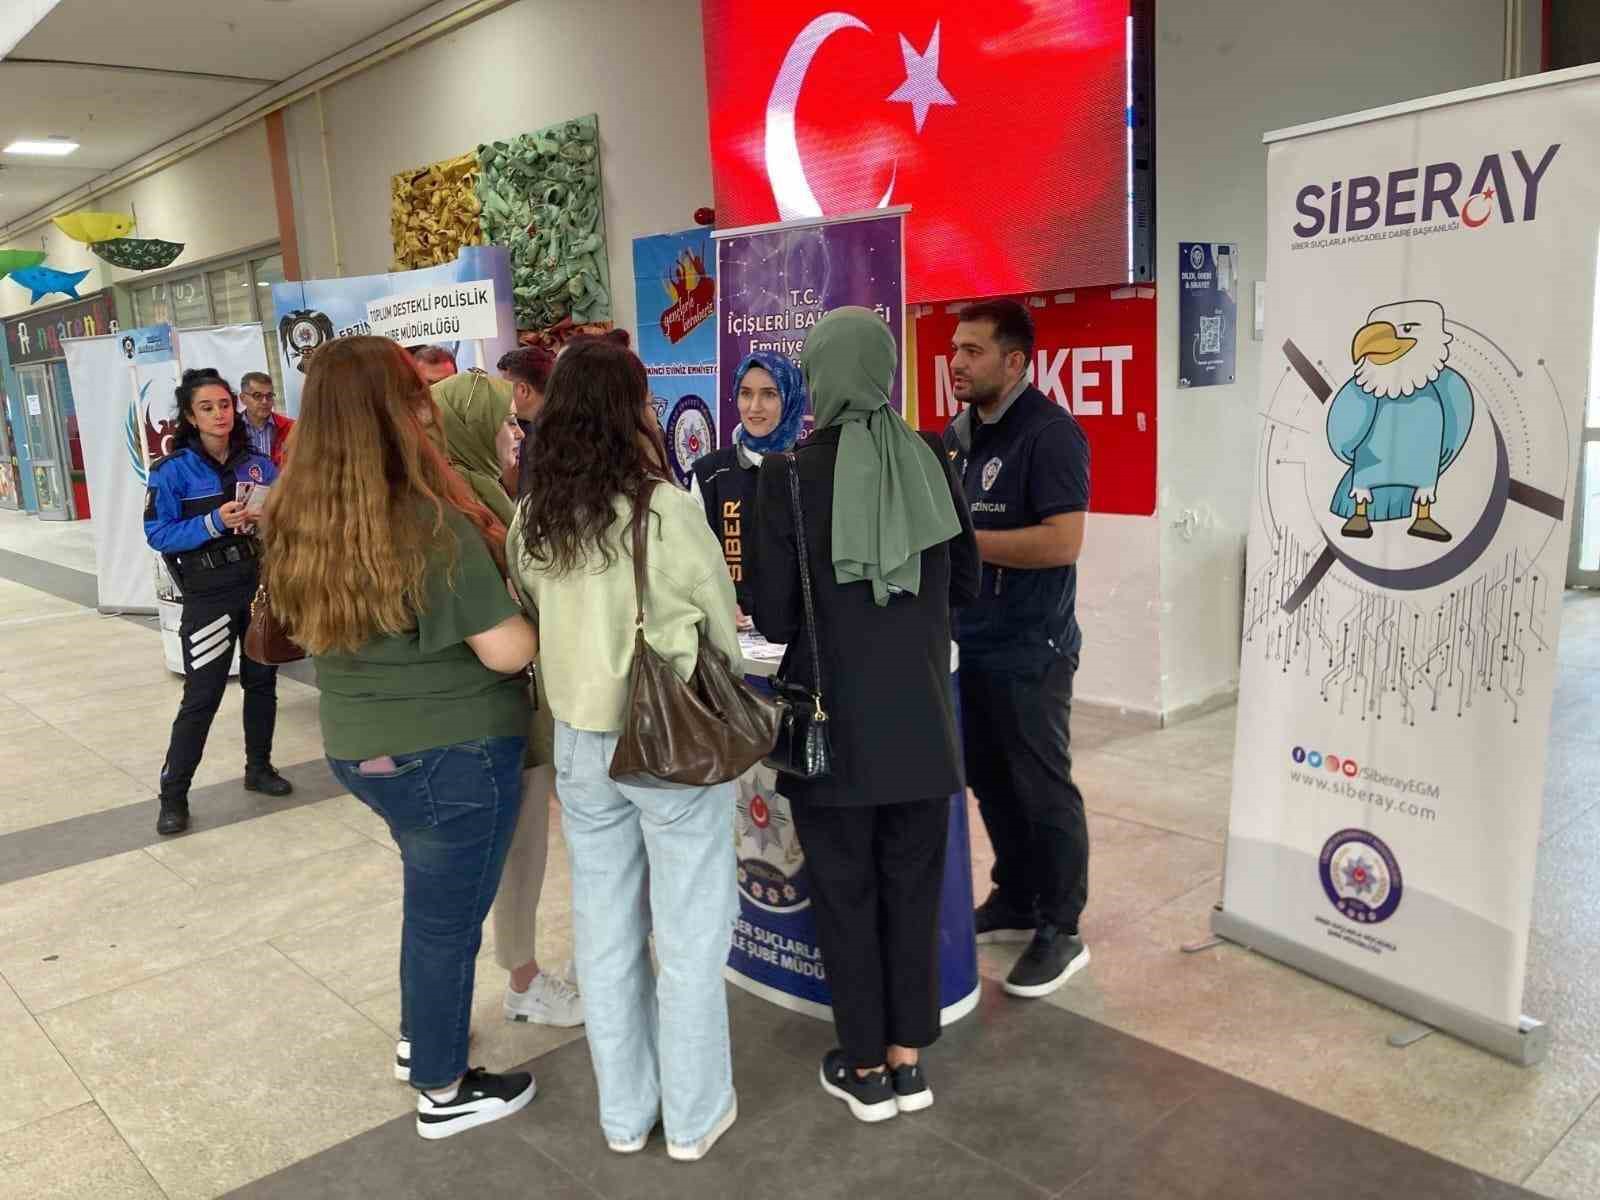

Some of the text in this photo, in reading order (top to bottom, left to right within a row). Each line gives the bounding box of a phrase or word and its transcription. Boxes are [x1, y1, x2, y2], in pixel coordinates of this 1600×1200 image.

[1293, 144, 1561, 238] SİBERAY
[369, 287, 488, 322] TOPLUM DESTEKLİ POLİSLİK
[790, 288, 819, 306] T.C.
[338, 320, 372, 340] ERZİN
[400, 316, 461, 338] MÜDÜRLÜĞÜ
[728, 310, 790, 336] İÇİŞLERİ
[750, 337, 804, 355] Emniye
[935, 345, 1133, 417] MKET
[1289, 769, 1436, 822] www.siberay.com
[753, 926, 822, 961] SUÇLARLA
